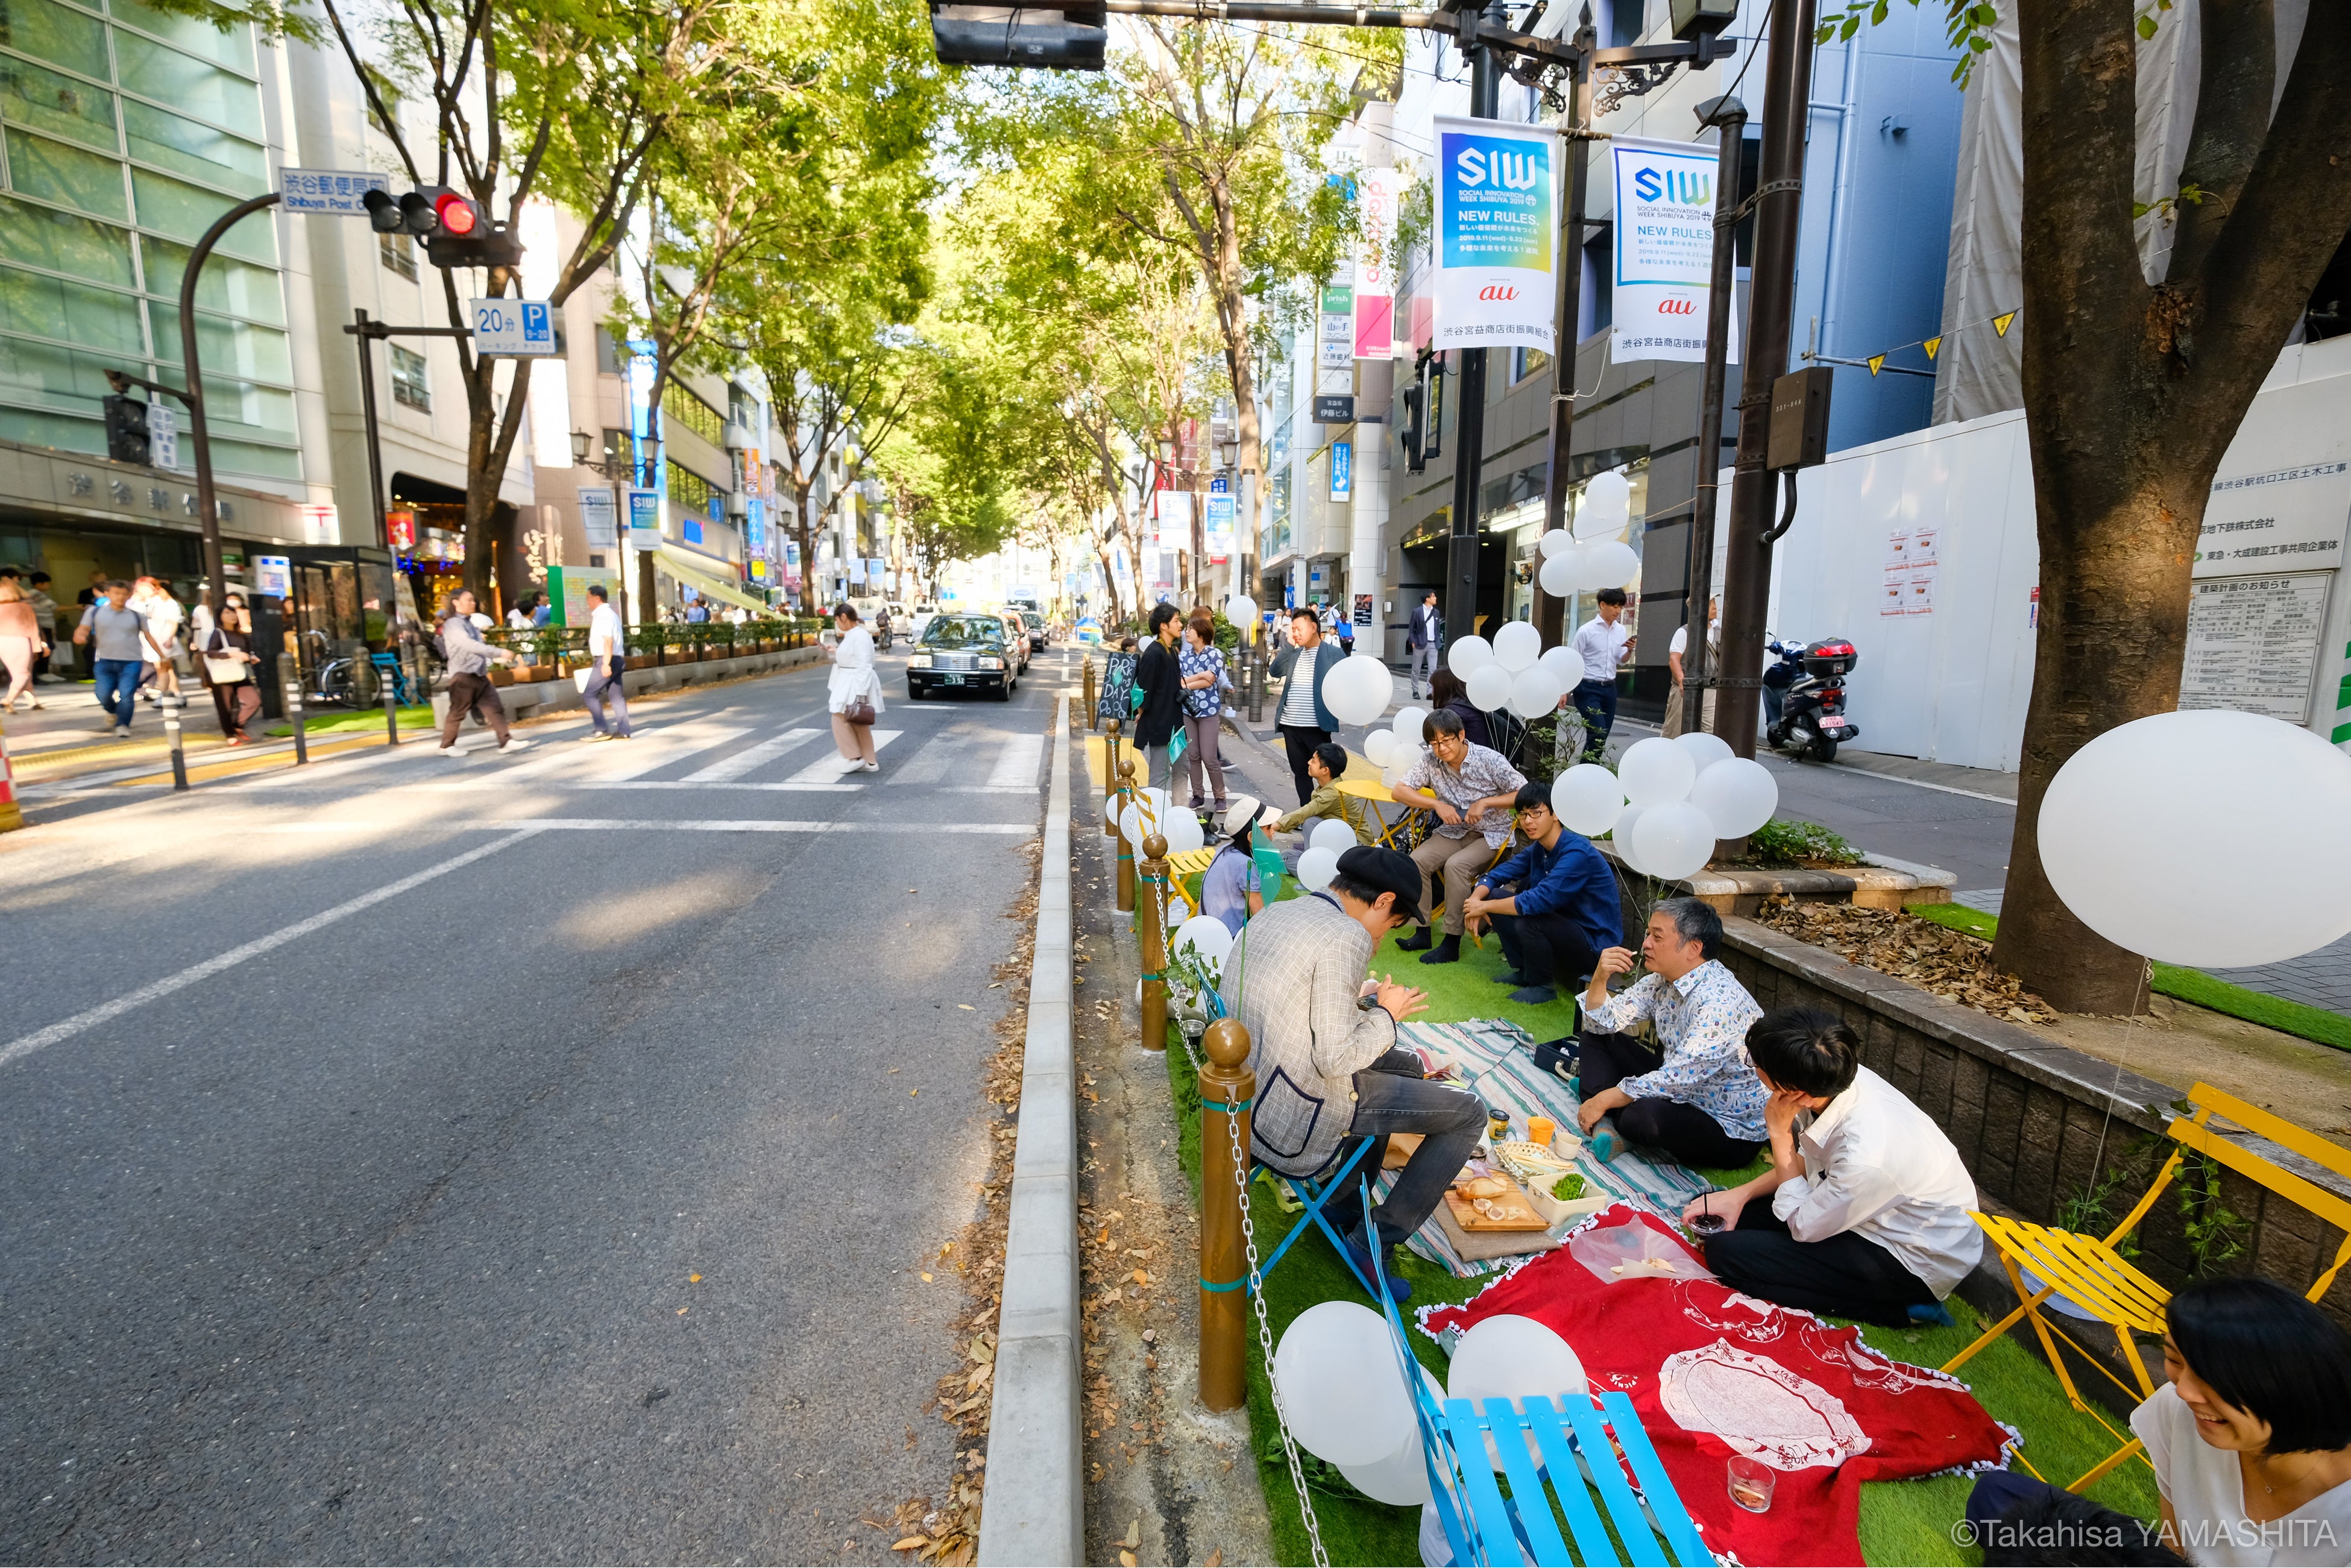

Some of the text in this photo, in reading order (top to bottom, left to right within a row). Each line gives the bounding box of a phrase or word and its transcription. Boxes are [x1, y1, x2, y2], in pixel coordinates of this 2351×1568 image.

[1458, 147, 1536, 190] SIW
[1635, 167, 1711, 206] SIW
[1485, 190, 1524, 199] INNOVATION
[287, 197, 326, 209] Shibuya
[329, 199, 352, 209] Post
[1662, 207, 1700, 215] INNOVATION
[1459, 210, 1540, 226] NEW RULES.
[1638, 225, 1667, 236] NEW
[1479, 286, 1520, 301] au
[1658, 300, 1697, 315] au
[1327, 323, 1348, 331] 山の手
[1444, 324, 1549, 340] 渋谷宮益商店街振興組合
[634, 497, 655, 508] SIW
[1210, 501, 1230, 512] SIW
[2200, 580, 2290, 593] 建築計画のお知らせ
[1104, 684, 1130, 700] DAY
